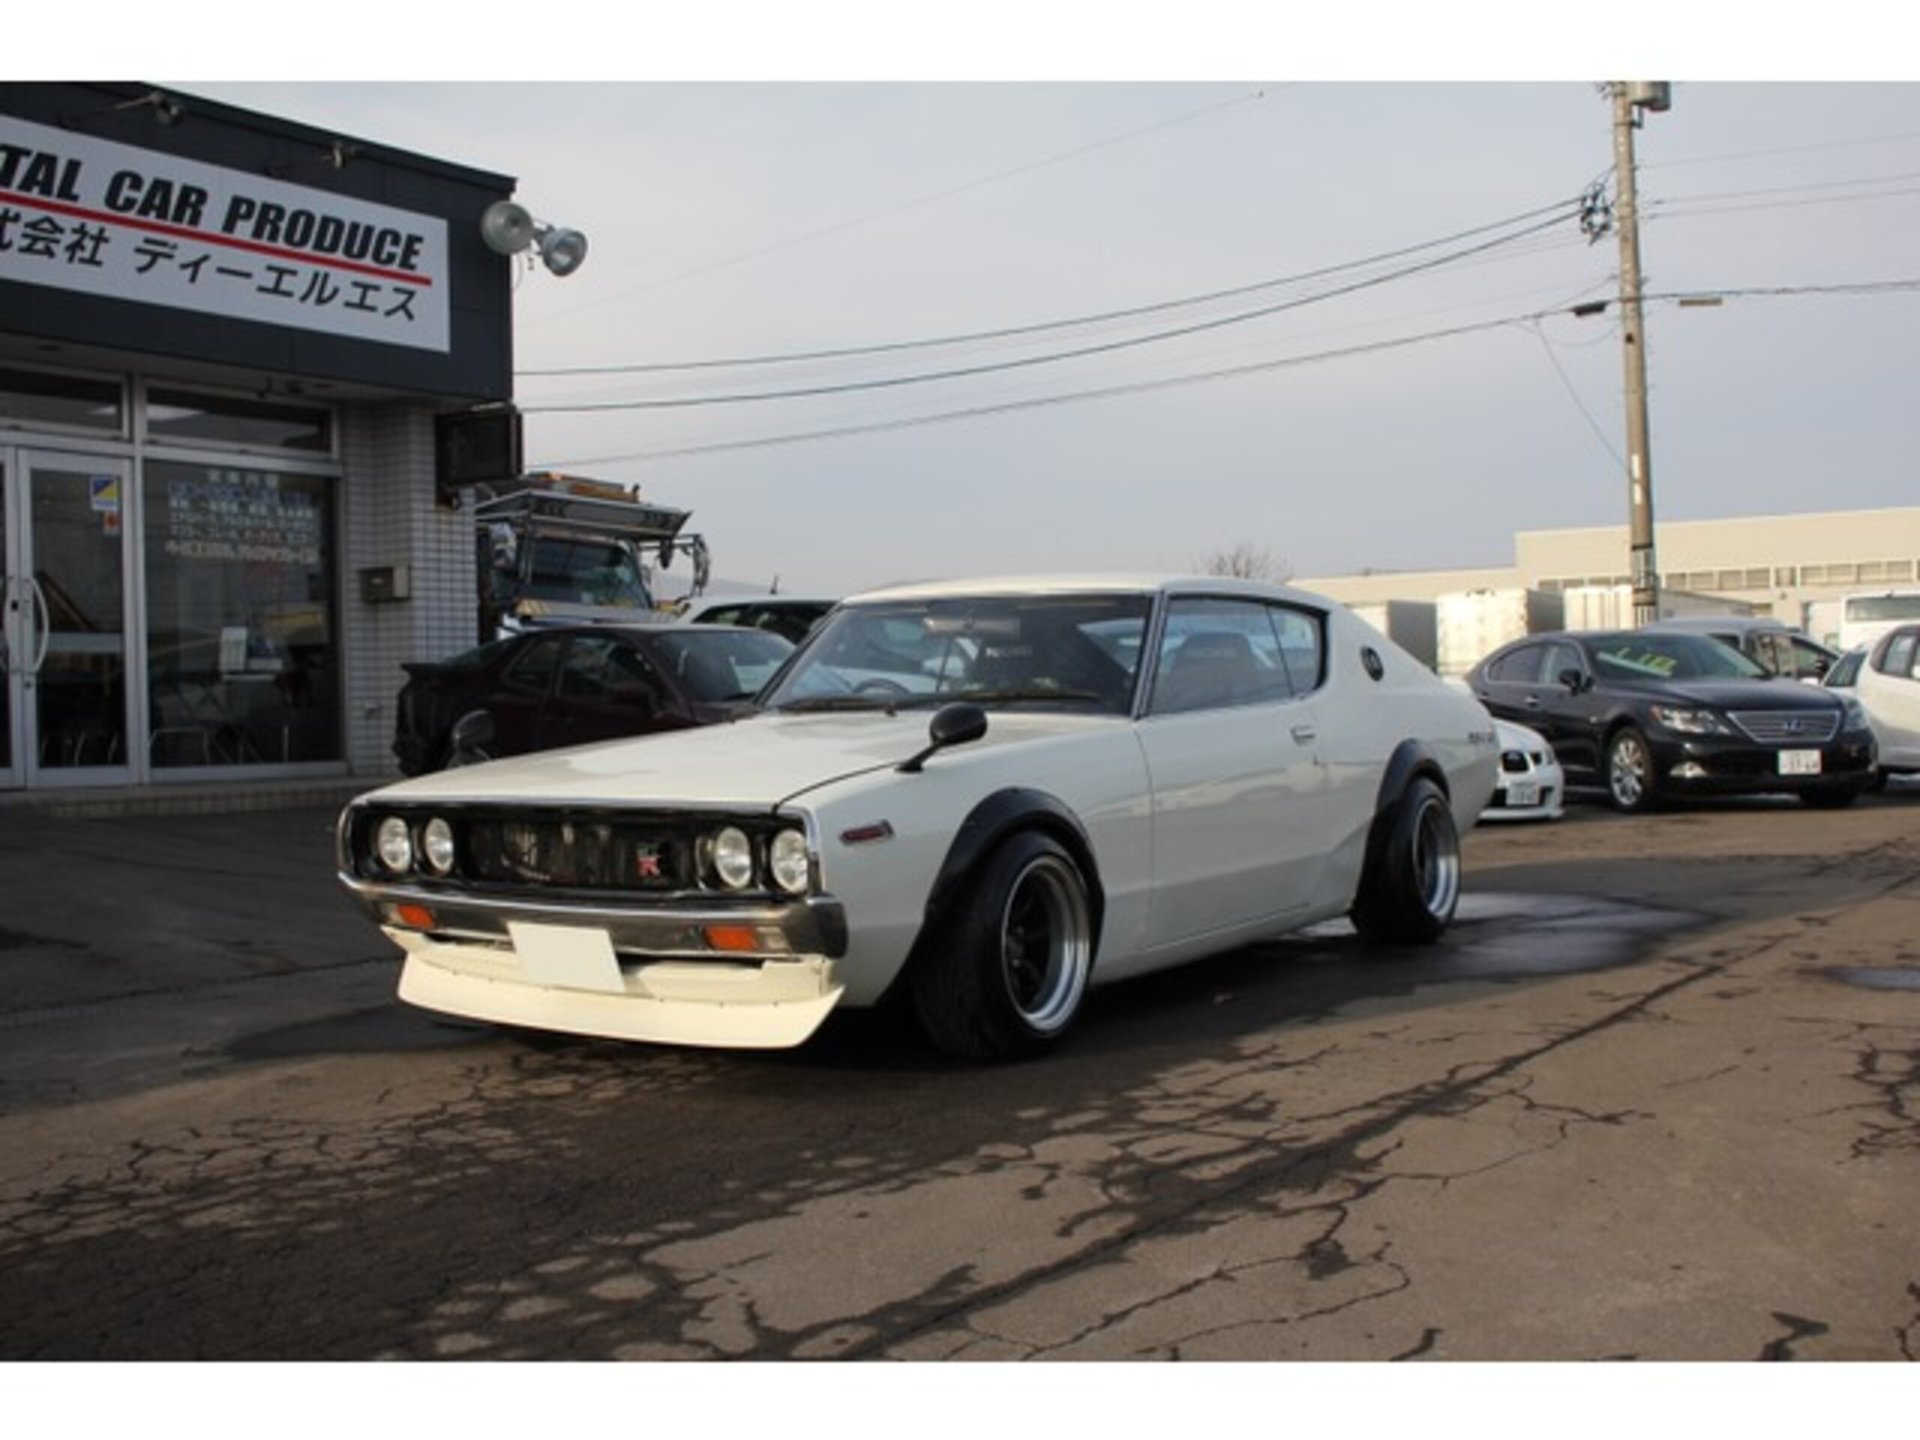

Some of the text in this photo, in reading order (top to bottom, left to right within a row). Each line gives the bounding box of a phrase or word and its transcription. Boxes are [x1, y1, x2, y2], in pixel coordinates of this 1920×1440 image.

[104, 169, 208, 228] CAR
[221, 194, 424, 271] PRODUCE
[134, 237, 418, 322] ディーエルエス
